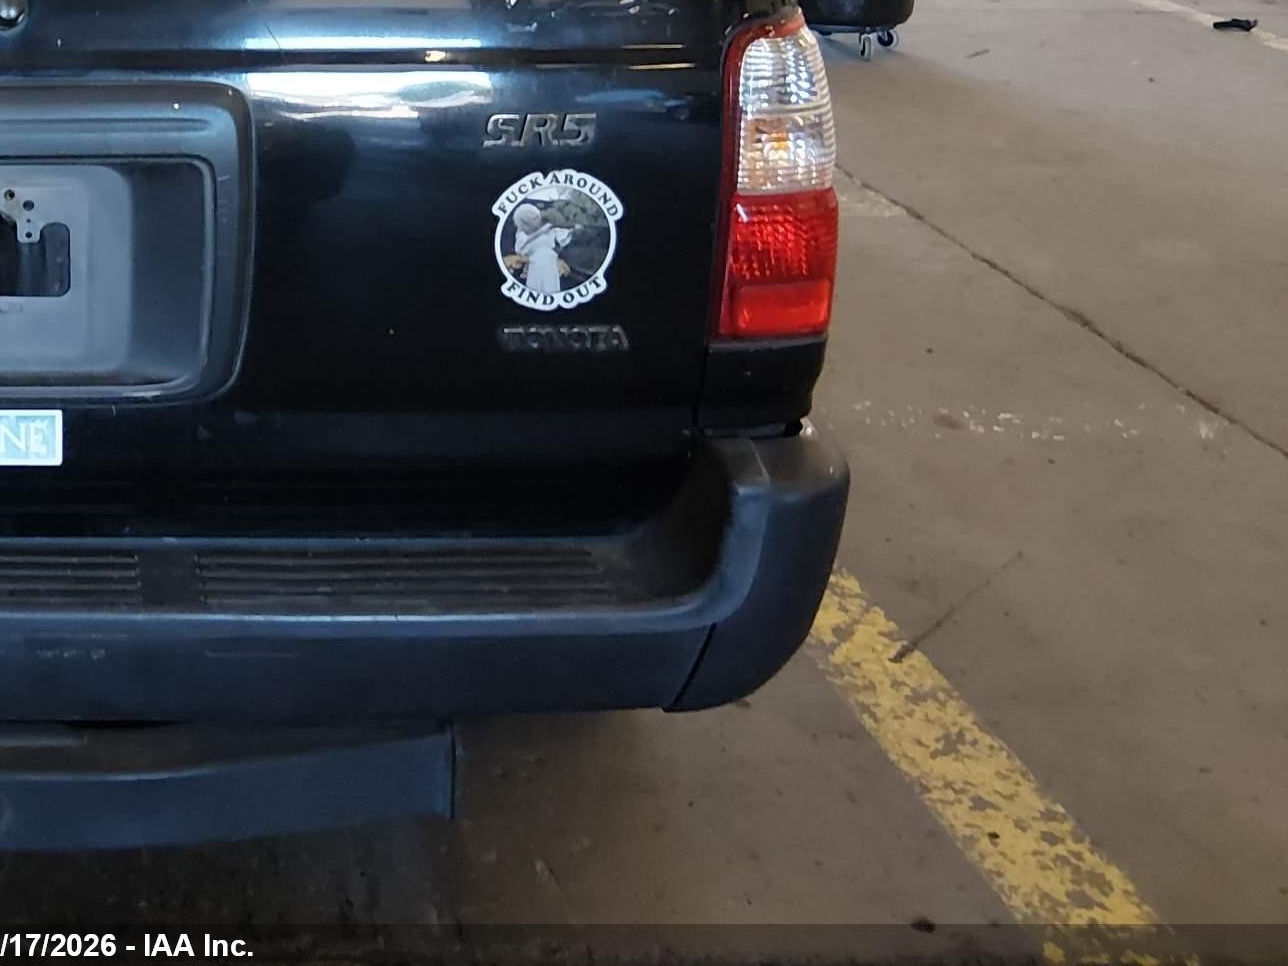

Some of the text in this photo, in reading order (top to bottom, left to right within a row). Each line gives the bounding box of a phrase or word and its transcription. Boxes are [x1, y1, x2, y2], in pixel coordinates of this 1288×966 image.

[481, 112, 598, 148] SR5
[497, 172, 620, 218] FUCK AROUND
[506, 275, 603, 306] FIND OUT
[502, 323, 630, 351] TOYOTA
